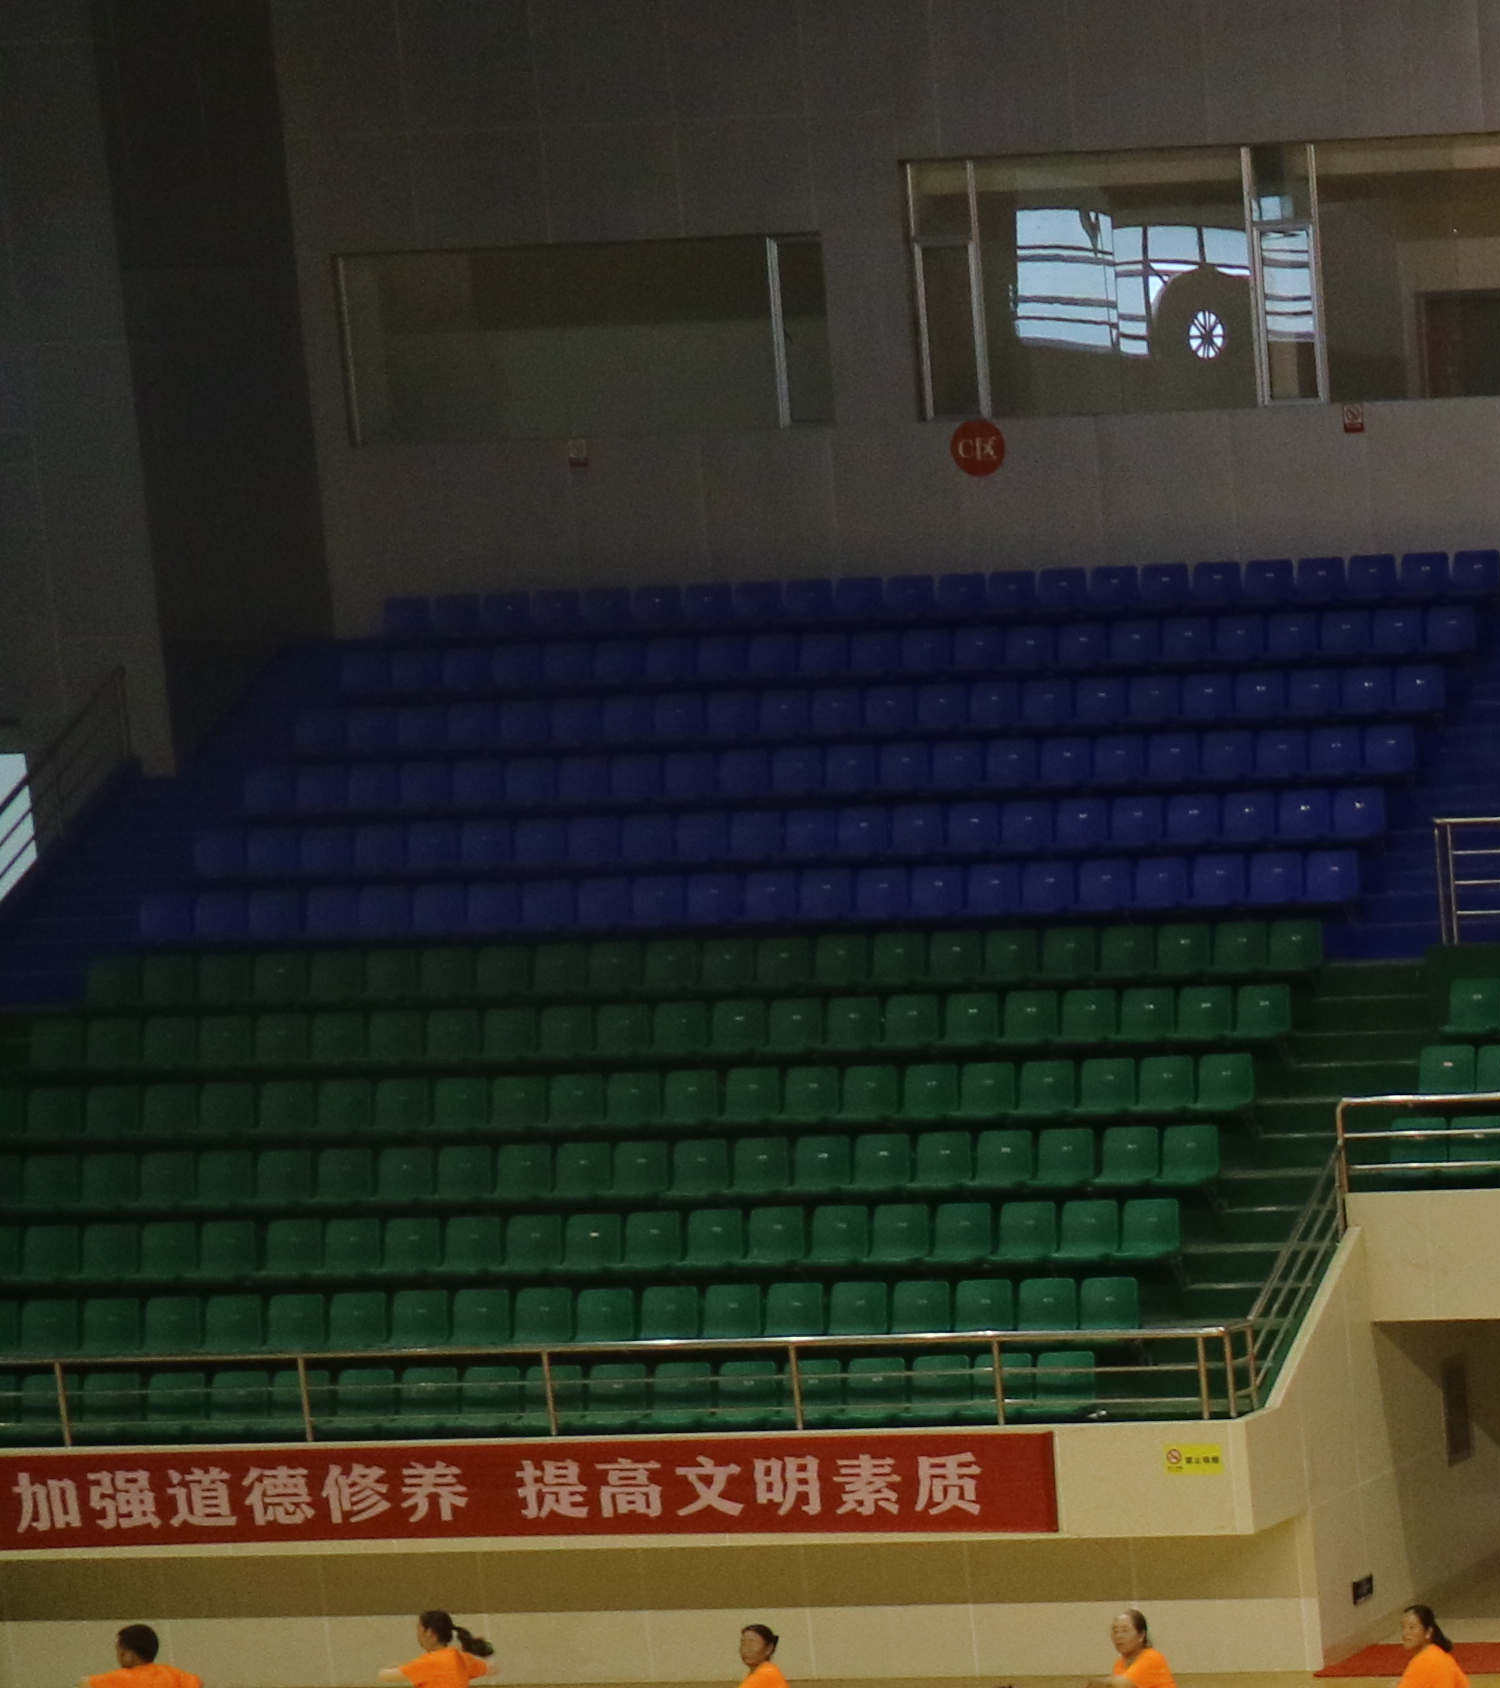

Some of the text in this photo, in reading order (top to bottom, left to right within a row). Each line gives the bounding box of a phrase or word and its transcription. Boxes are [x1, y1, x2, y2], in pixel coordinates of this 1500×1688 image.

[13, 1452, 984, 1533] 加强道德修养 提高文明素质
